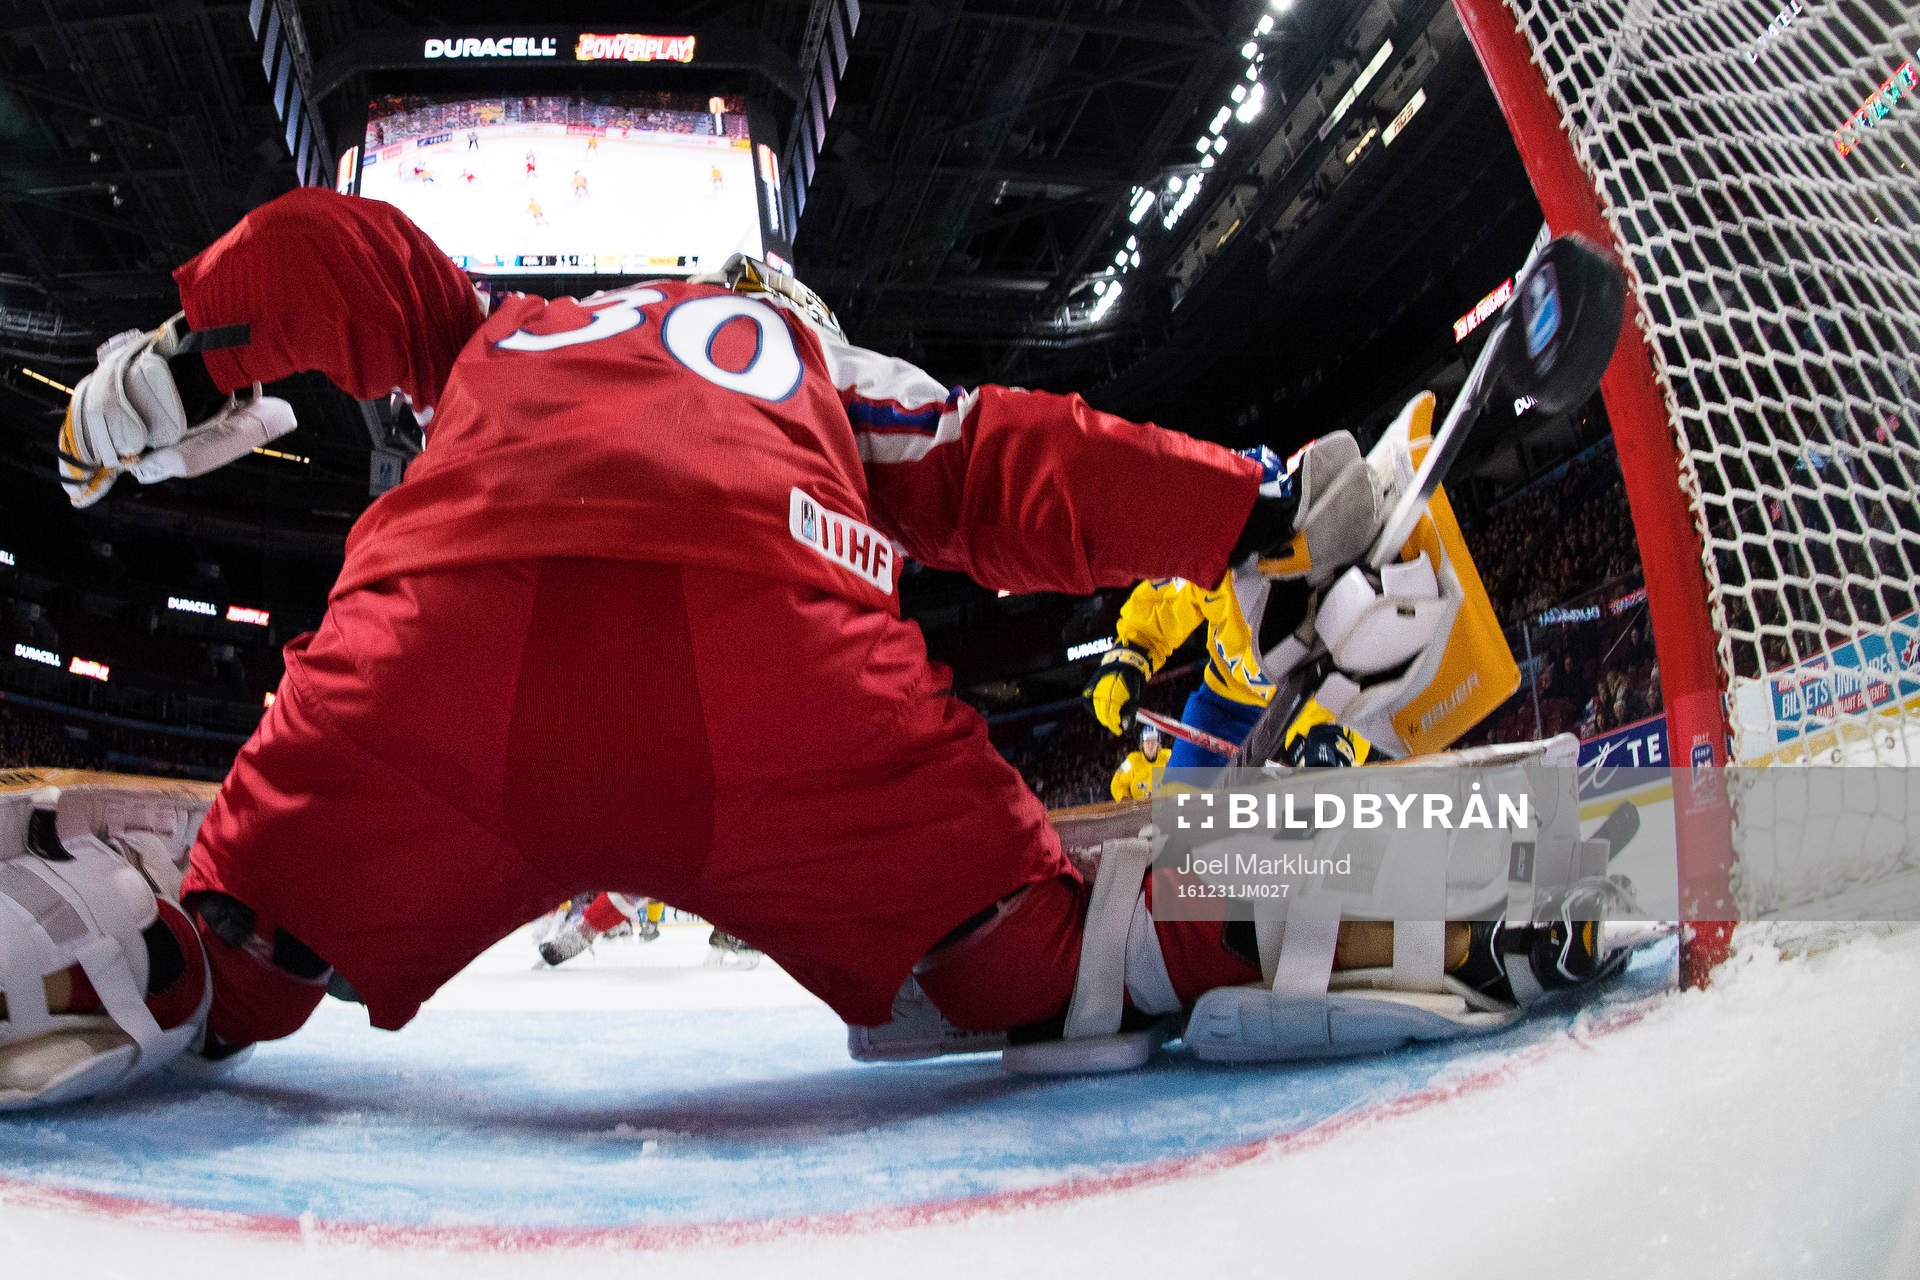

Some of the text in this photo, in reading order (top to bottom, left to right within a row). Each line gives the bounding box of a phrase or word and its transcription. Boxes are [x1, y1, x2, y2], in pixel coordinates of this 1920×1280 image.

[424, 37, 556, 58] DURACELL
[579, 37, 692, 62] POWERPLAY
[494, 284, 805, 404] 30
[821, 513, 887, 579] IIHF
[168, 597, 217, 616] DURACELL
[15, 644, 61, 667] DURACELL
[1067, 636, 1113, 662] DURACELL
[1420, 671, 1481, 733] BAUER
[1782, 678, 1828, 719] BILETS
